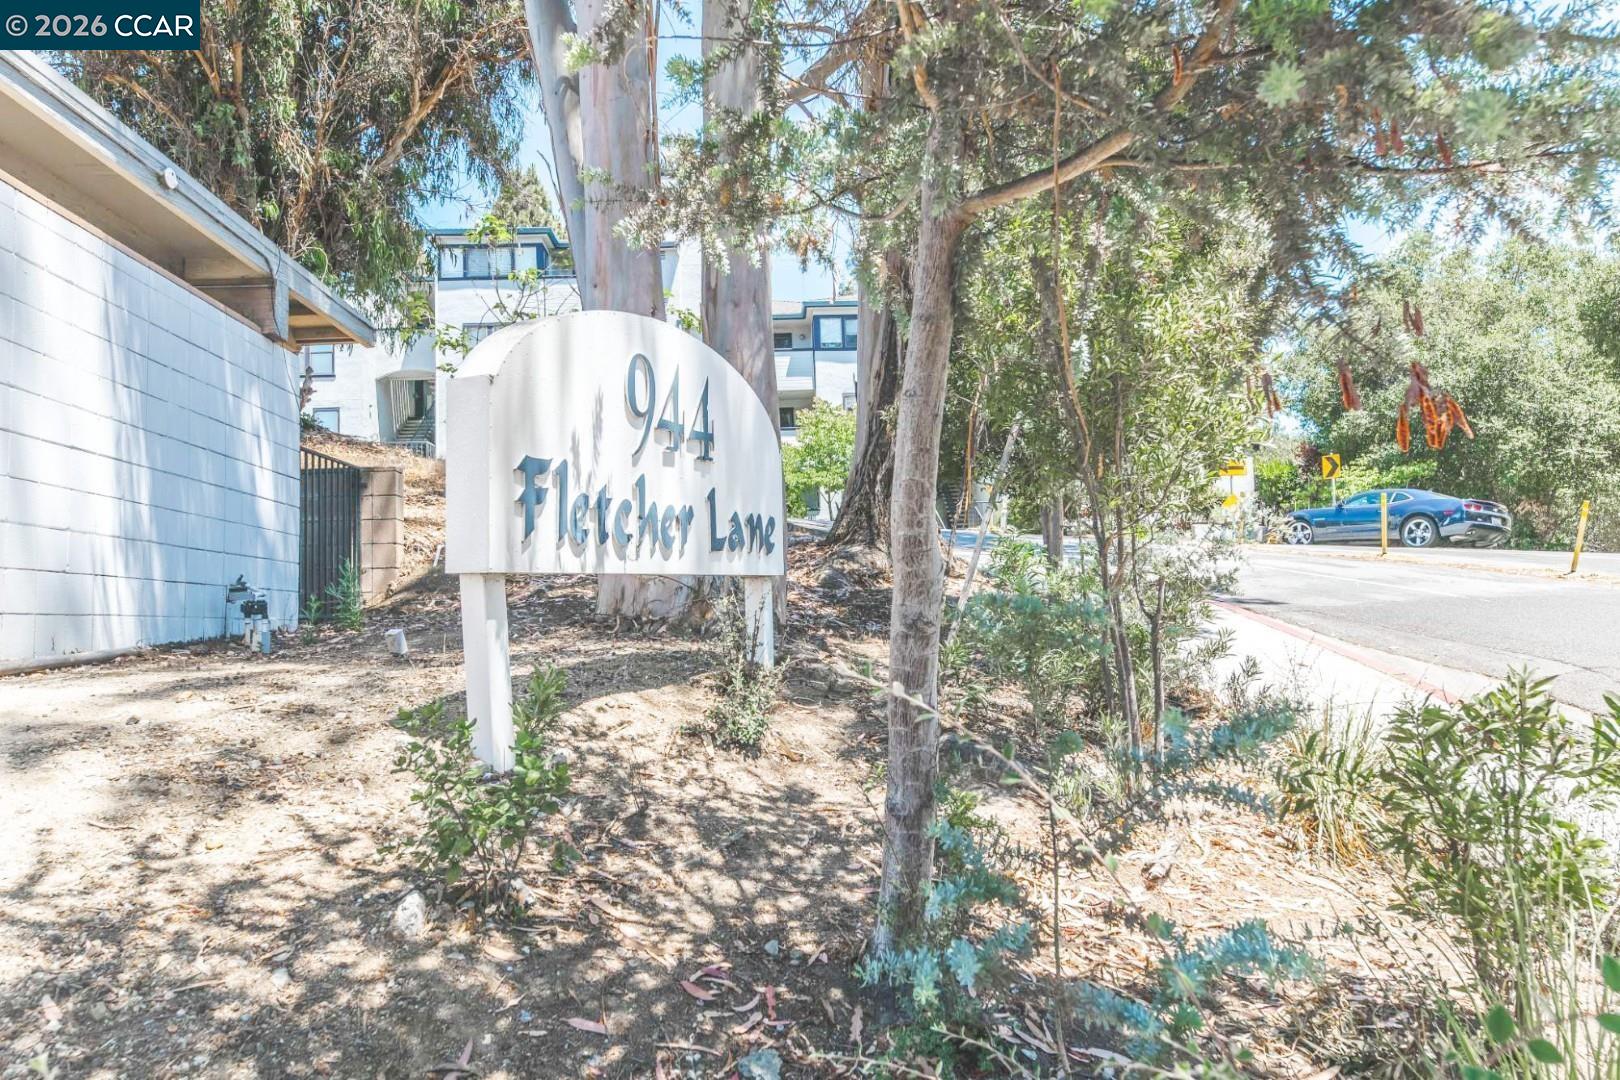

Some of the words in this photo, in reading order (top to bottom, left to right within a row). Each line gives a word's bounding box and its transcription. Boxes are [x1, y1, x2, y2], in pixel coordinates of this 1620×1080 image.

[627, 353, 715, 461] 944
[513, 455, 695, 555] Fletcher
[707, 487, 776, 556] Lane
